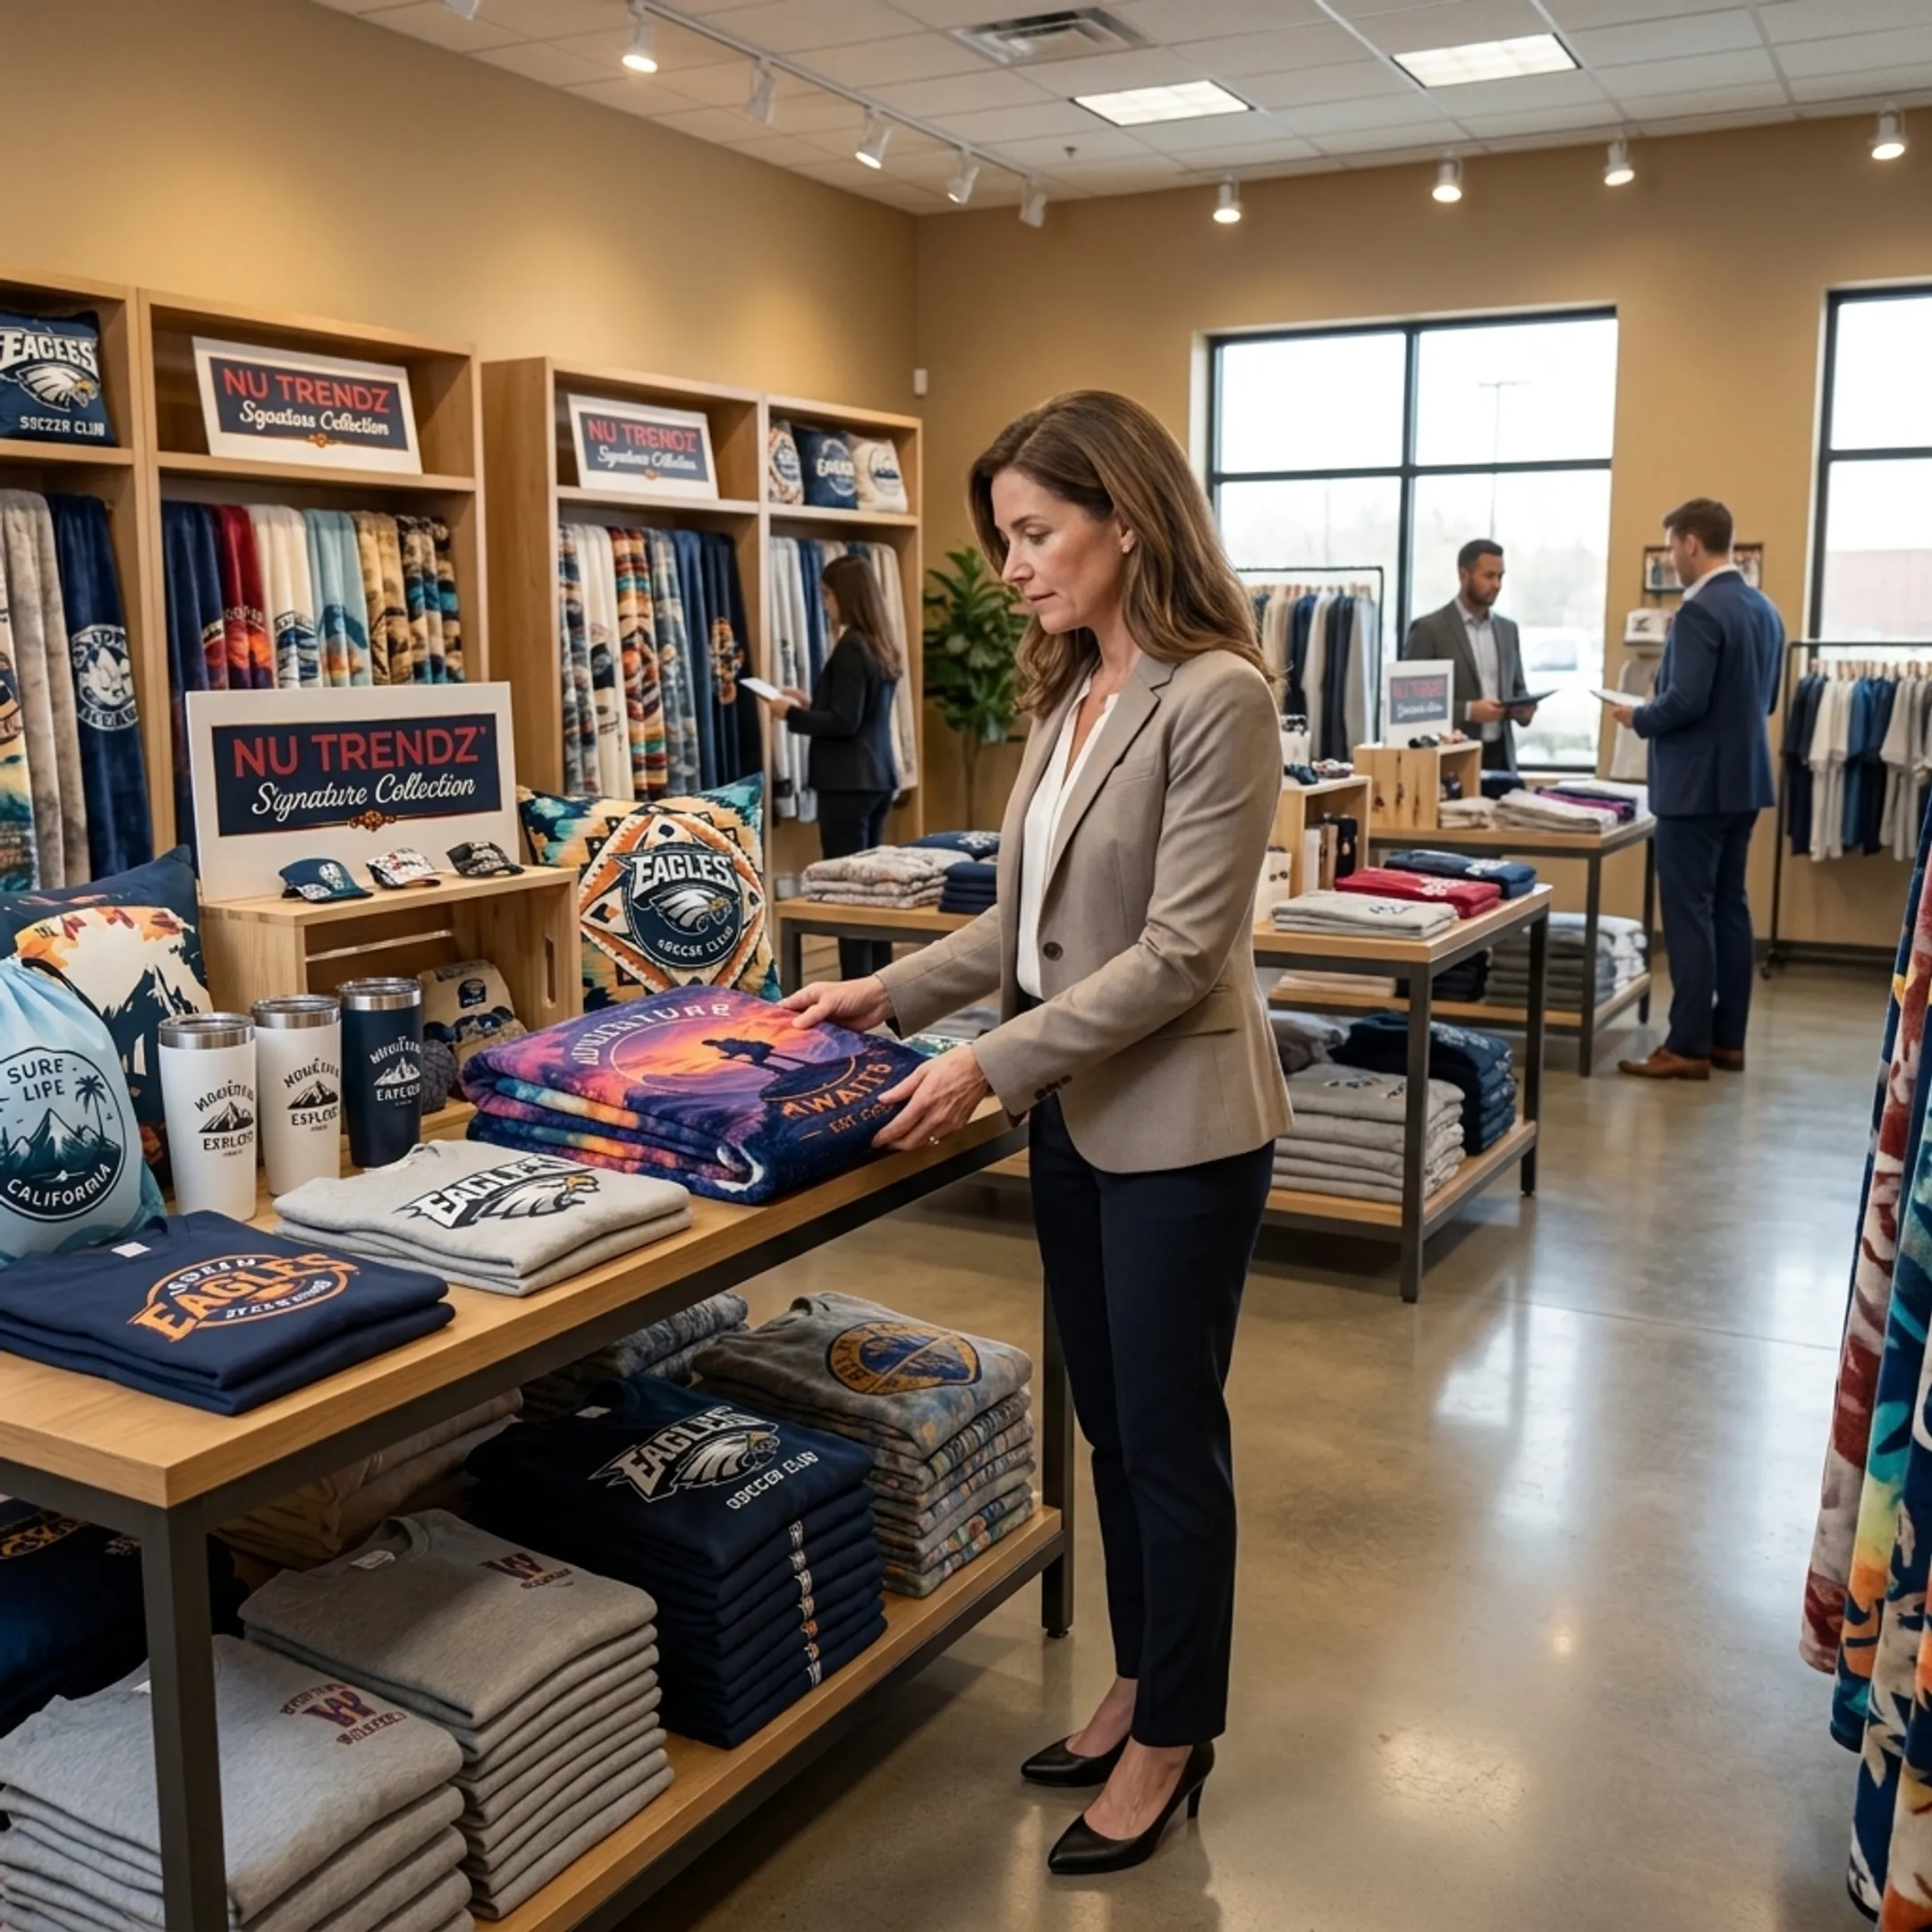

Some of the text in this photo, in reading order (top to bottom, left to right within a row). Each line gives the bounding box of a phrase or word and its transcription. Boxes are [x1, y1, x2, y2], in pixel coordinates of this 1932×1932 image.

[223, 368, 390, 413] NU TRENDZ
[587, 419, 617, 444] NU
[233, 735, 298, 777] NU
[251, 773, 476, 822] Signature Collection
[7, 1058, 64, 1084] SURE
